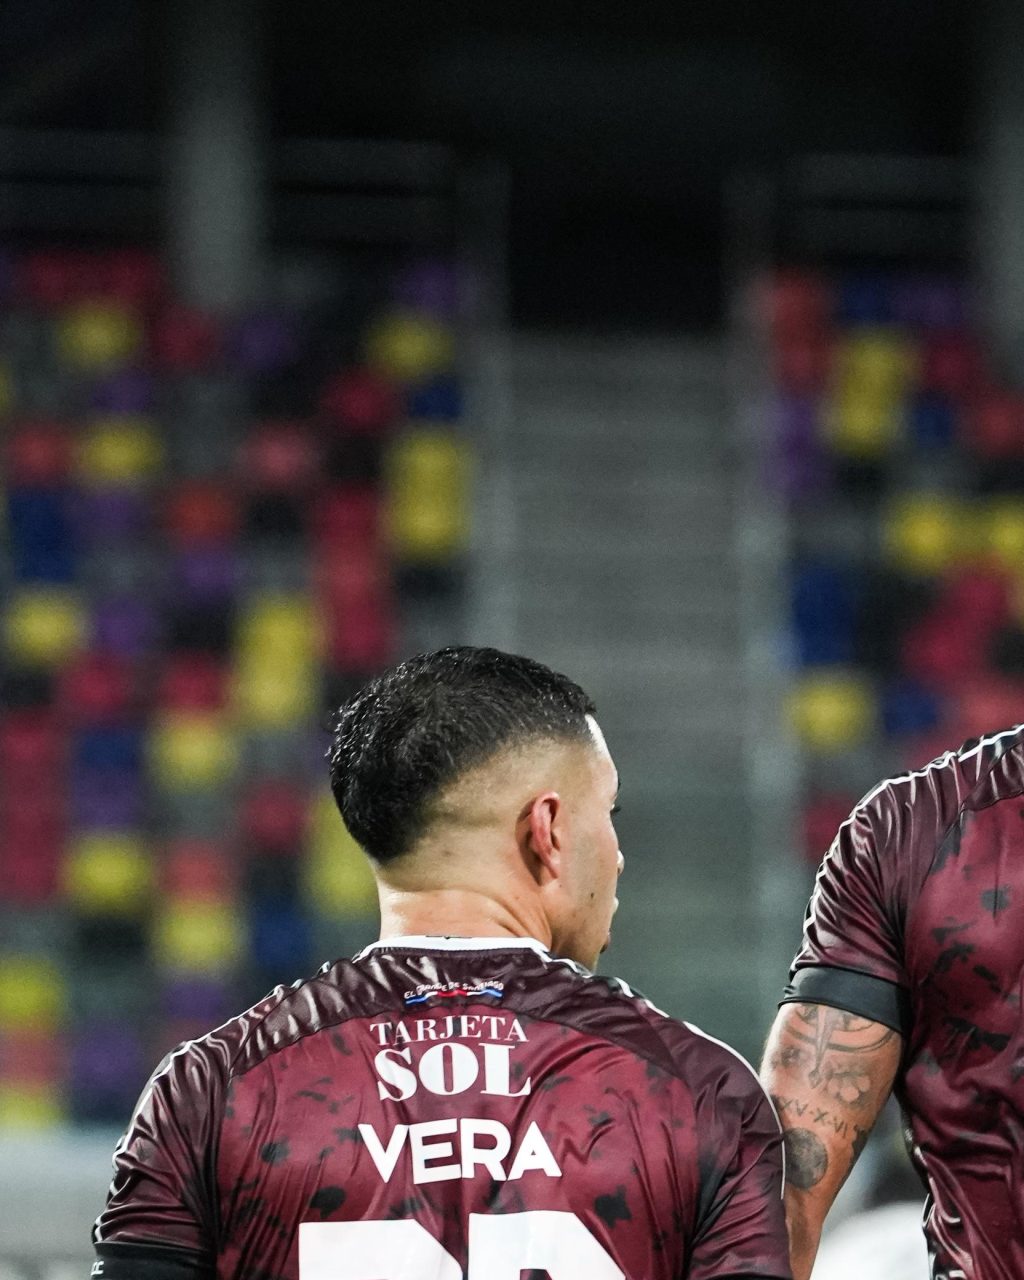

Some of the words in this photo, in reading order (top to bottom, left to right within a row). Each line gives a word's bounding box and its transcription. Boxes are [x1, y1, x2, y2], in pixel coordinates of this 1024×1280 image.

[370, 1015, 529, 1046] TARJETA
[373, 1042, 531, 1102] SOL
[358, 1118, 562, 1184] VERA
